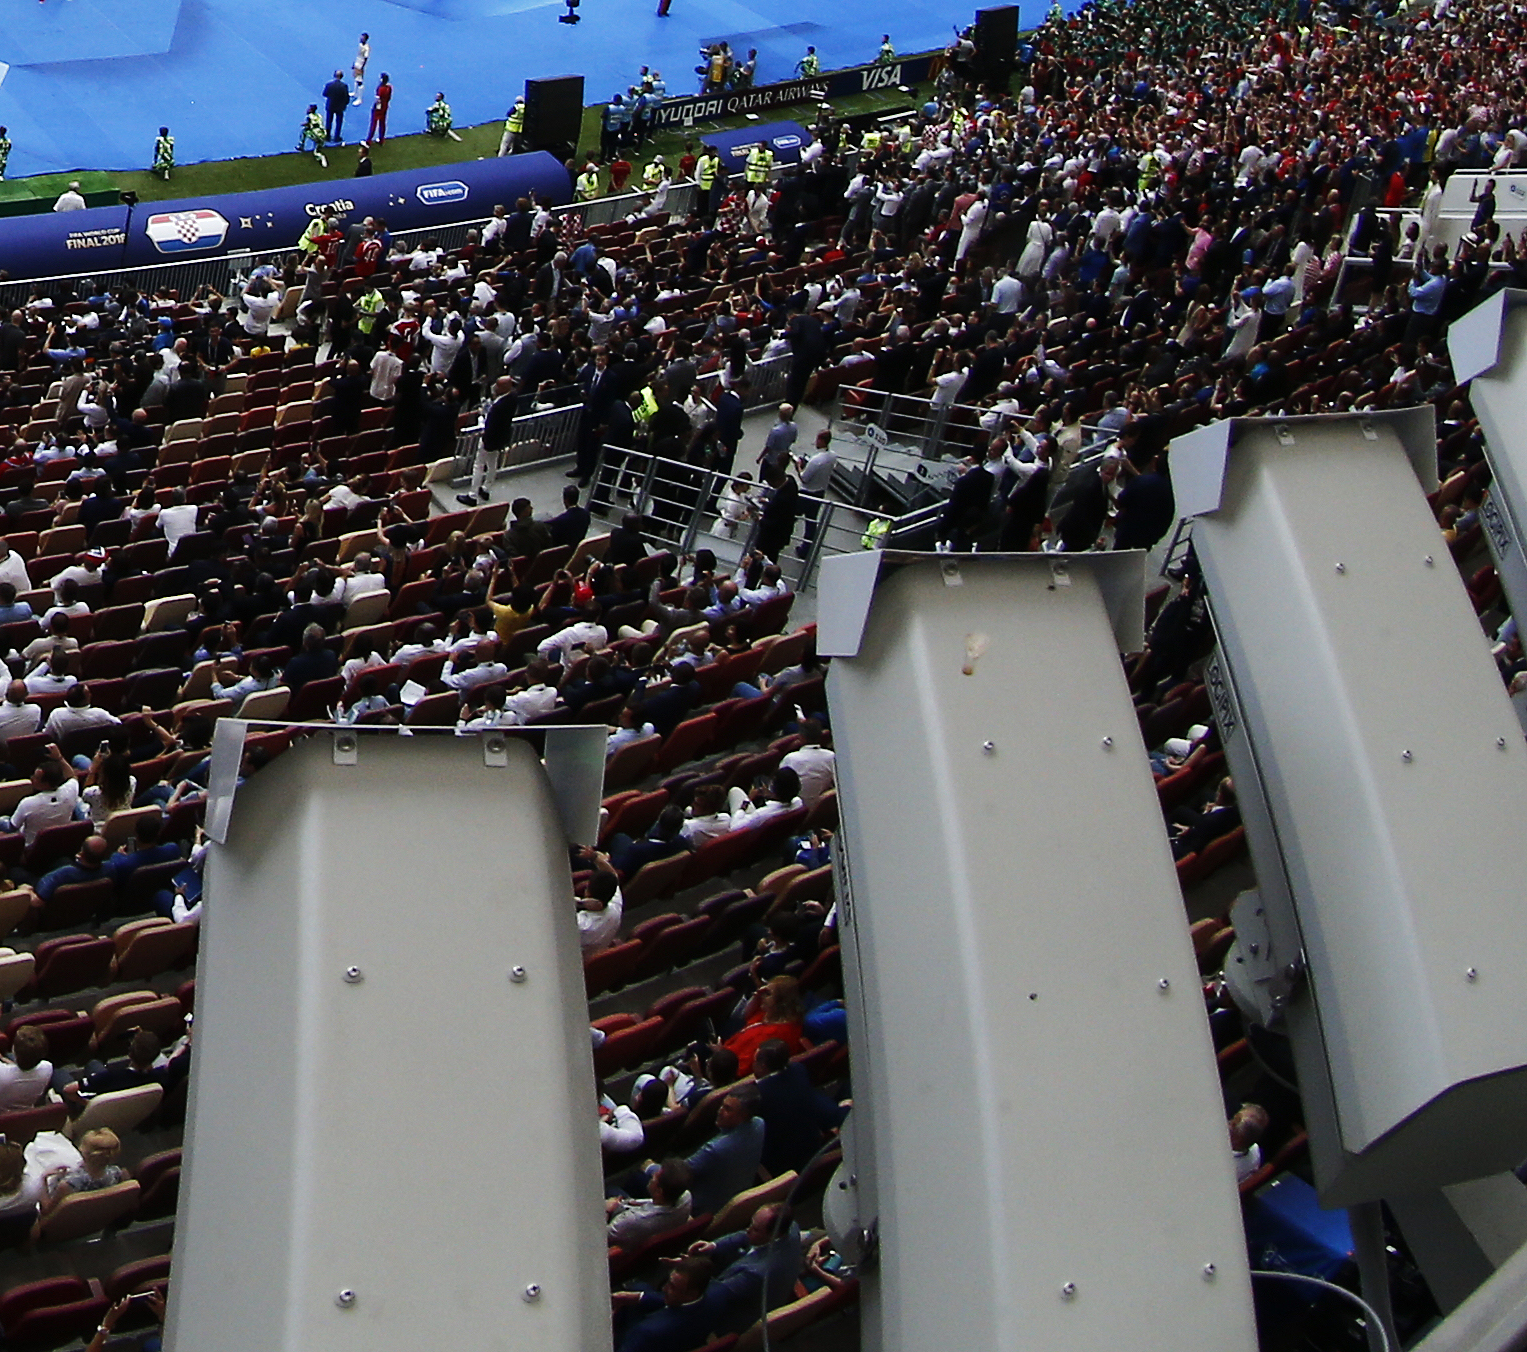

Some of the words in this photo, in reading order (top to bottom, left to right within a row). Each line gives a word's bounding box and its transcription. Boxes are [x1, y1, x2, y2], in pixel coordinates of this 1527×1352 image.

[860, 65, 902, 91] VISA
[727, 89, 772, 113] QATAR
[775, 81, 830, 103] AIRWAYS
[66, 236, 101, 249] FINAL
